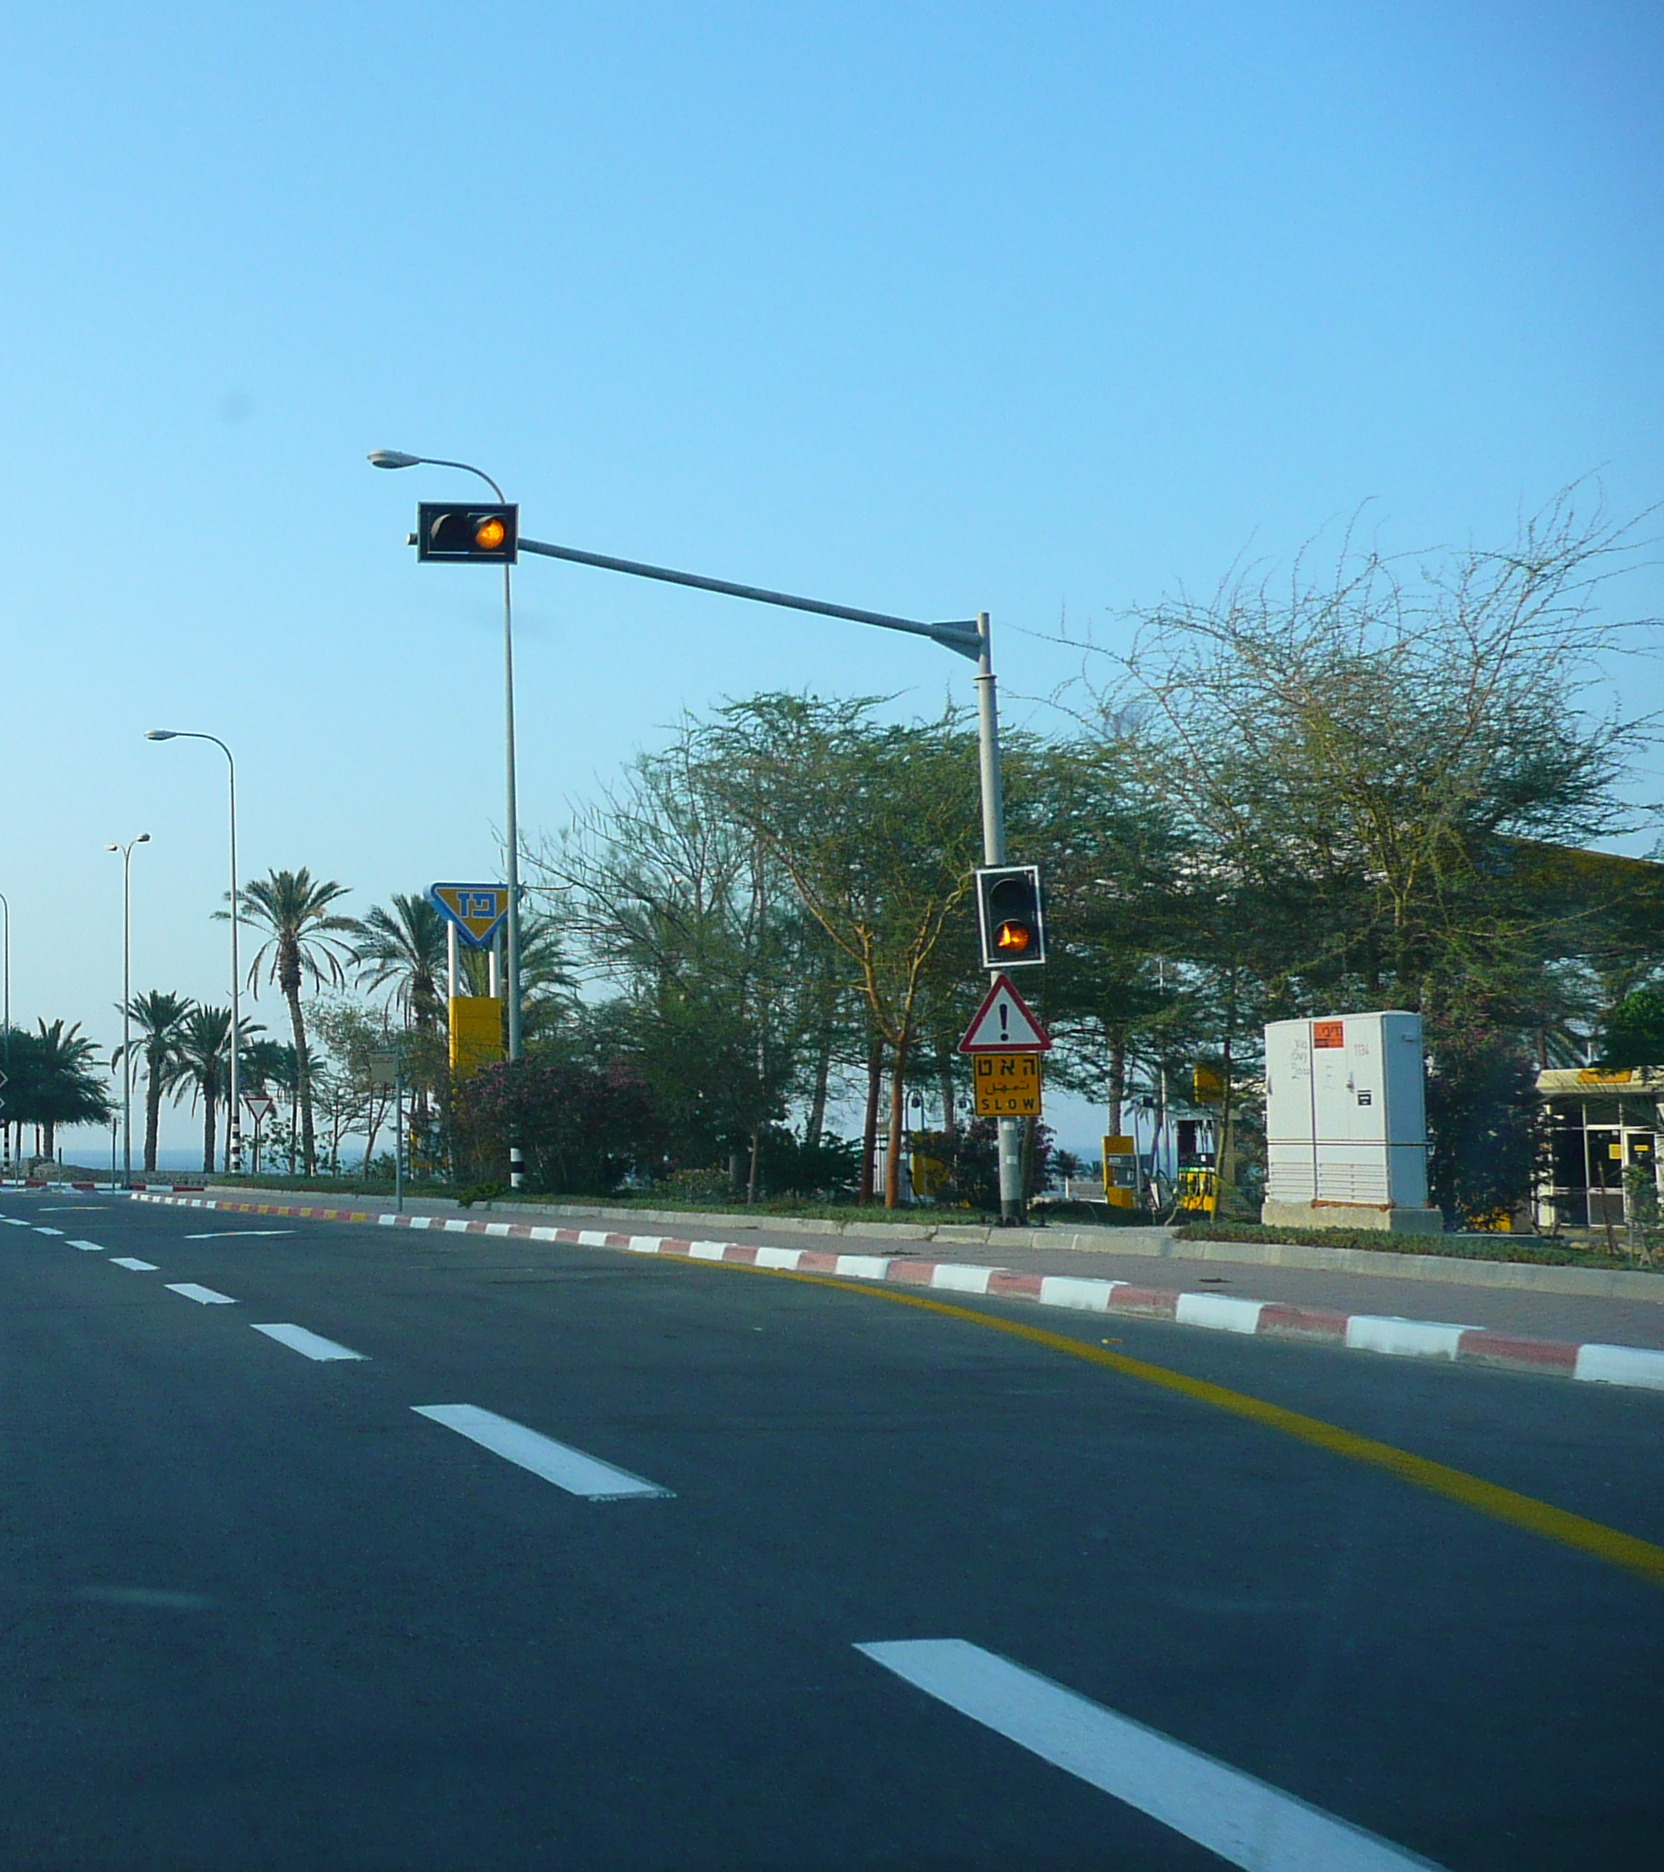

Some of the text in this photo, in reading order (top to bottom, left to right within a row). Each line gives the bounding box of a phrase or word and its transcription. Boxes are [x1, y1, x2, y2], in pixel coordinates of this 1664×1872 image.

[457, 891, 497, 919] פז
[978, 1059, 1036, 1076] האט
[981, 1098, 1035, 1110] SLOW
